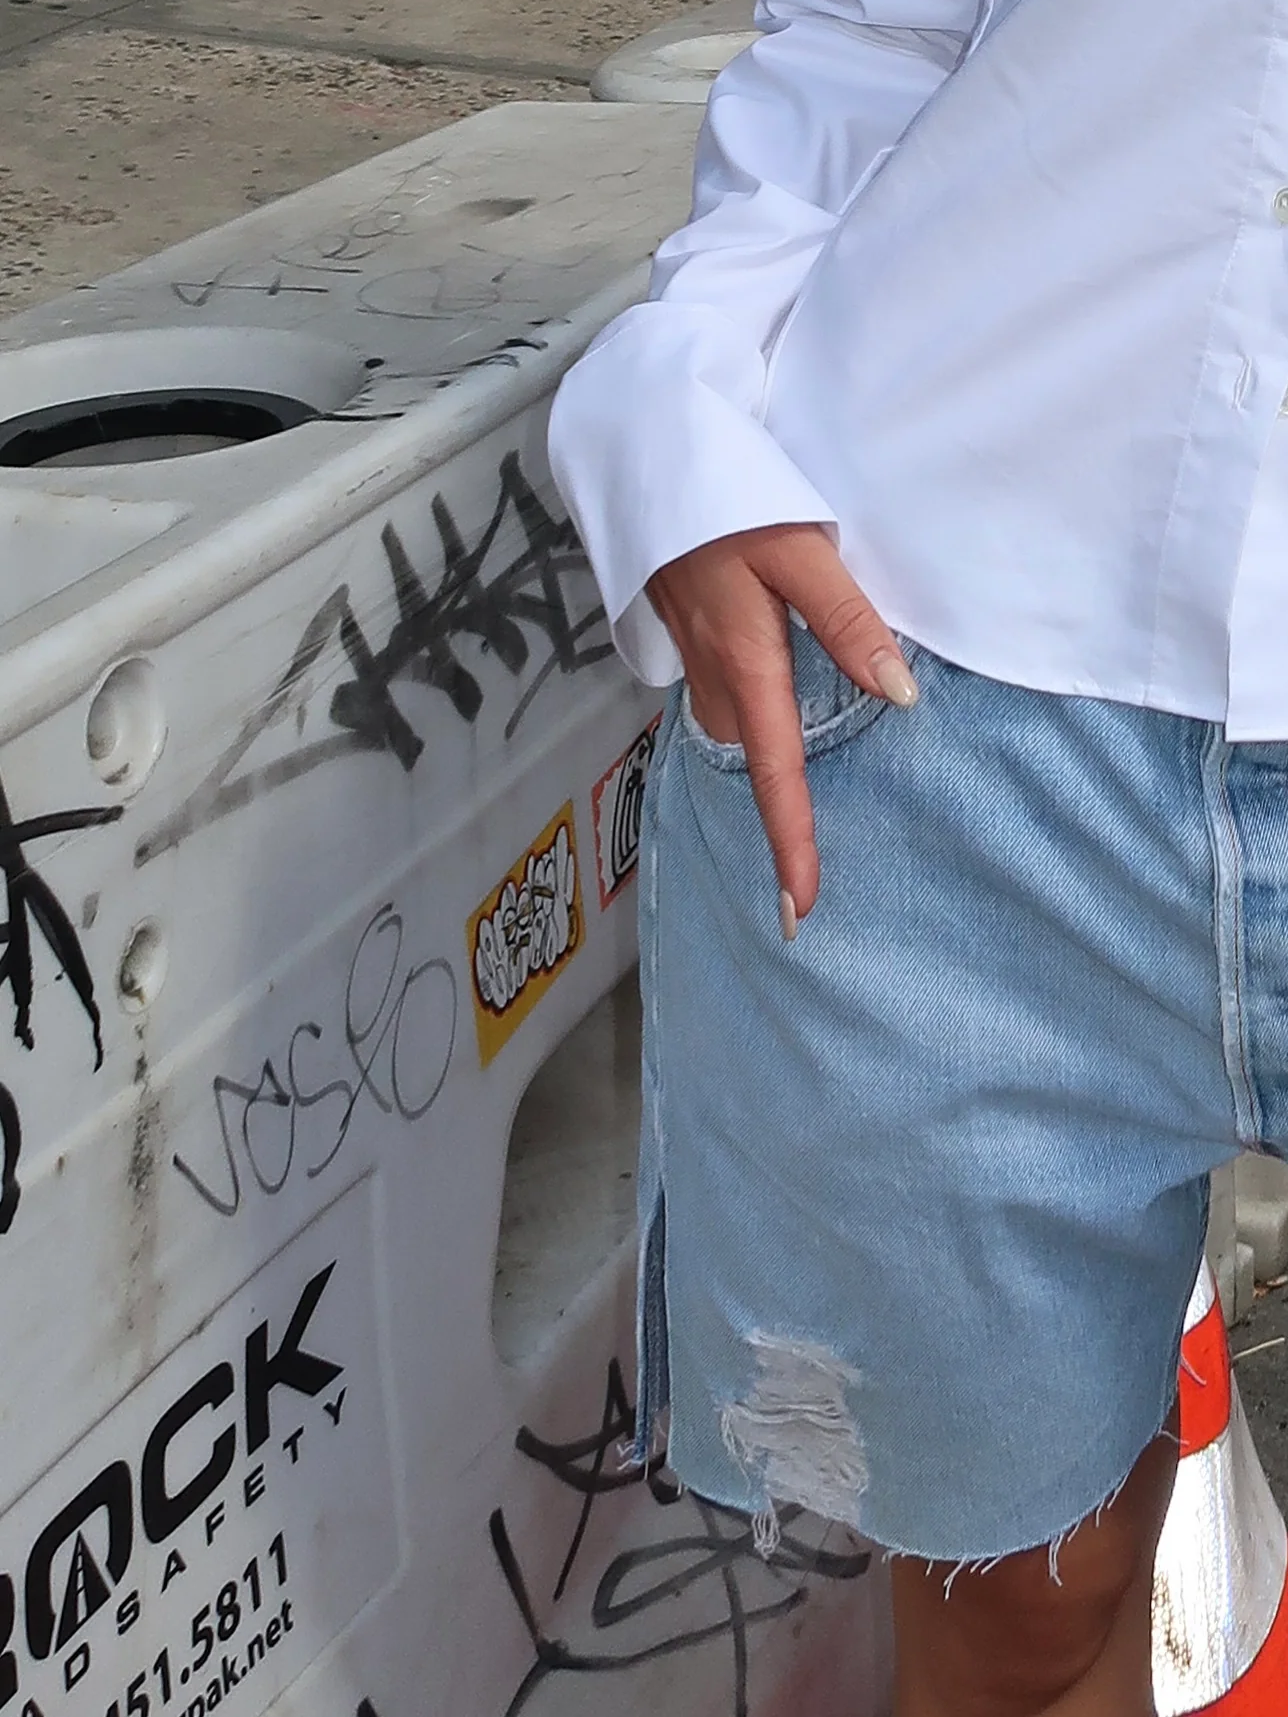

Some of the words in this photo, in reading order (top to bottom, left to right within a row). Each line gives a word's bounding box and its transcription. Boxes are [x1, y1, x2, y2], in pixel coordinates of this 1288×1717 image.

[0, 1259, 345, 1709] OCK
[105, 1530, 288, 1717] 51.5811
[179, 1597, 295, 1717] pak.net
